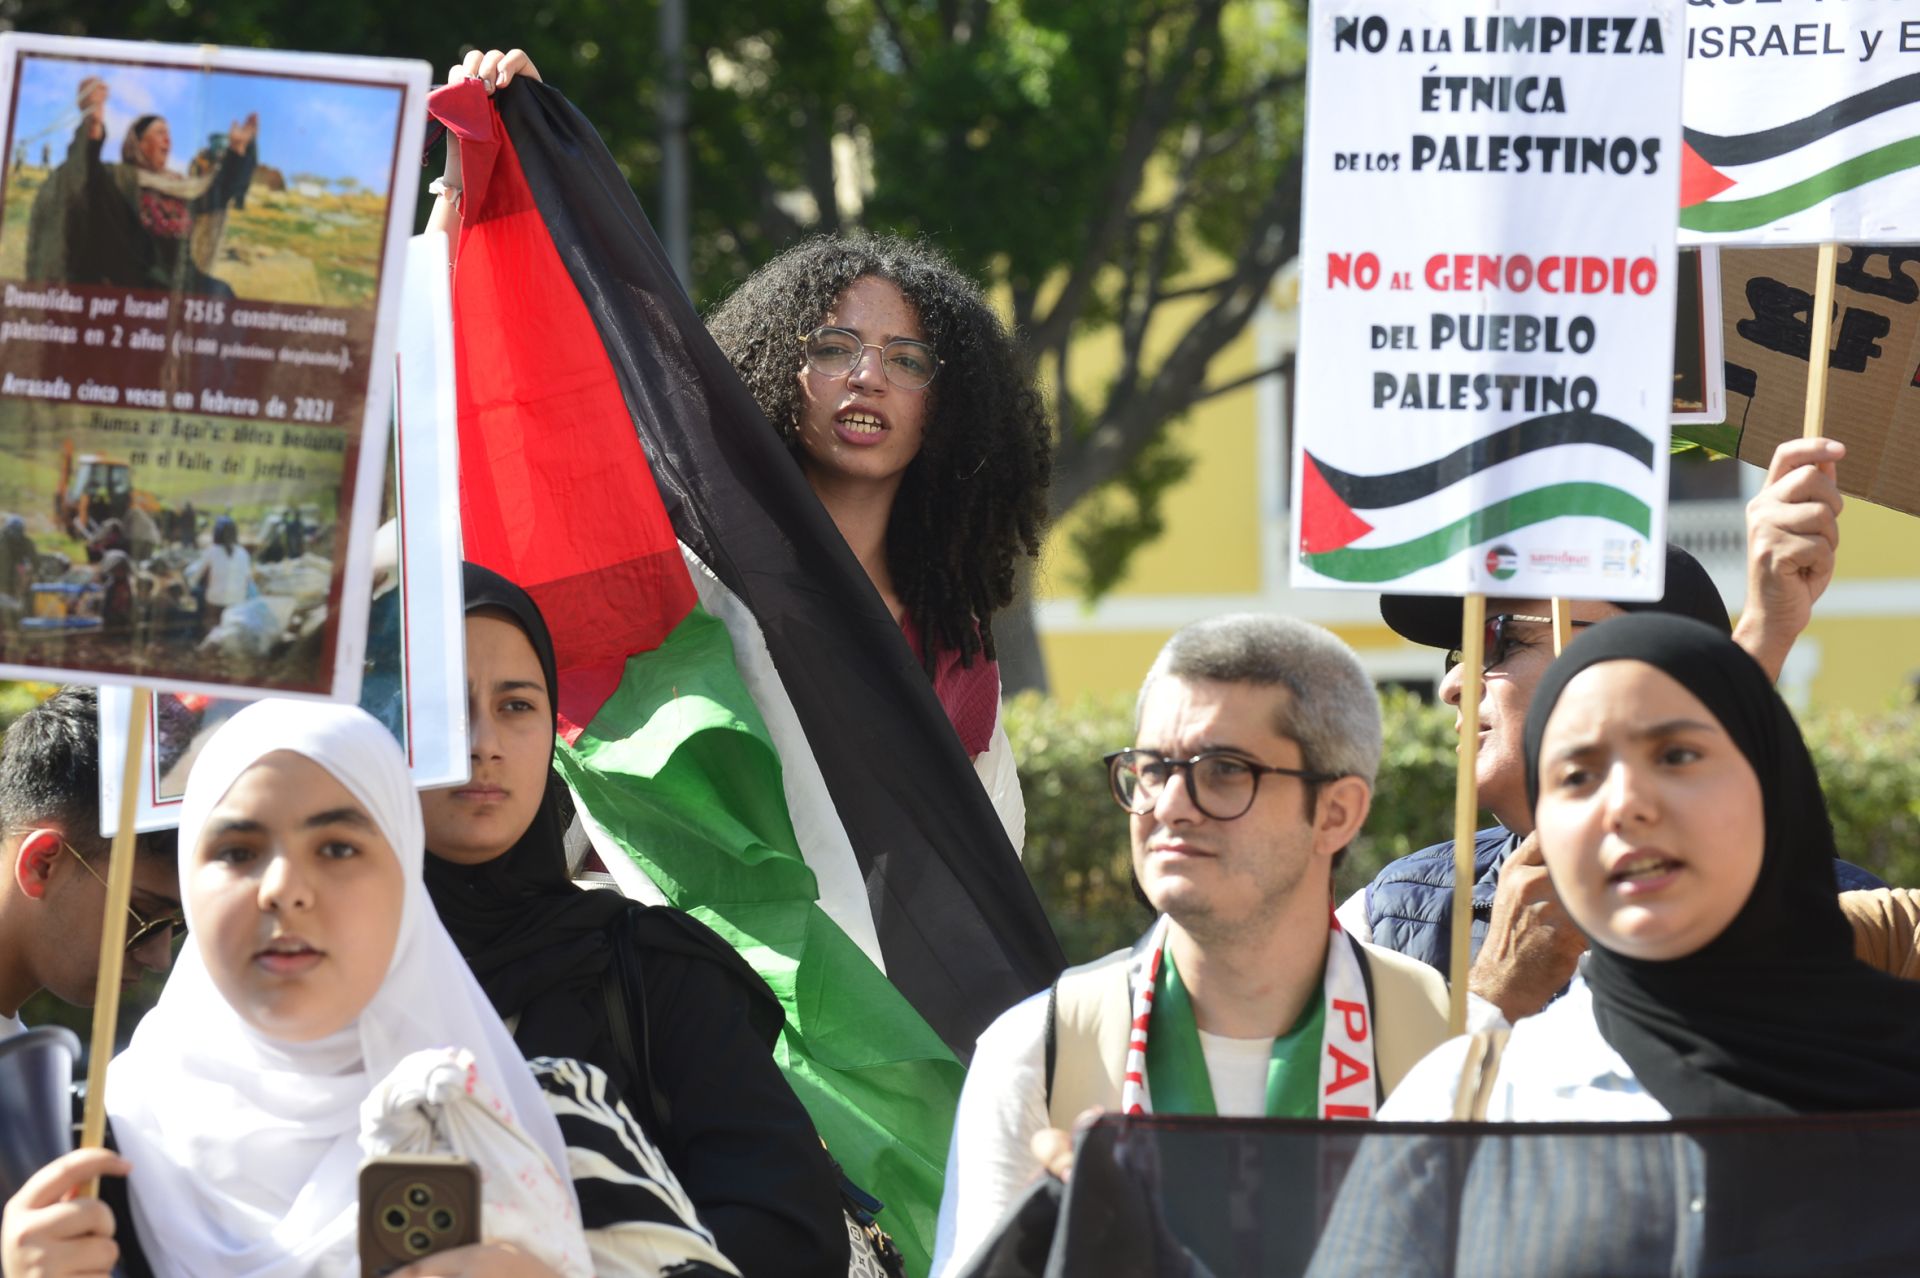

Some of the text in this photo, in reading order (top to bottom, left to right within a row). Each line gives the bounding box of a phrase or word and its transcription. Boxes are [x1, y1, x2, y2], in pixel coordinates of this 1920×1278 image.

[1334, 15, 1665, 54] NO A LA LIMPIEZA
[1687, 23, 1845, 59] ISRAEL
[1859, 30, 1884, 62] y
[1421, 65, 1567, 114] ÉTNICA
[1334, 134, 1661, 176] DE LOS PALESTINOS
[1327, 252, 1658, 296] NO AL GENOCIDIO
[4, 284, 347, 337] Demolidas por Israel 7515 construcciones
[0, 318, 78, 344] palestinas
[84, 328, 105, 345] en
[111, 325, 123, 348] 2
[129, 328, 165, 351] años
[1370, 313, 1597, 354] DEL PUEBLO
[1, 372, 335, 423] Arrasada cinco veces en febrero de 2021
[1373, 371, 1598, 412] PALESTINO
